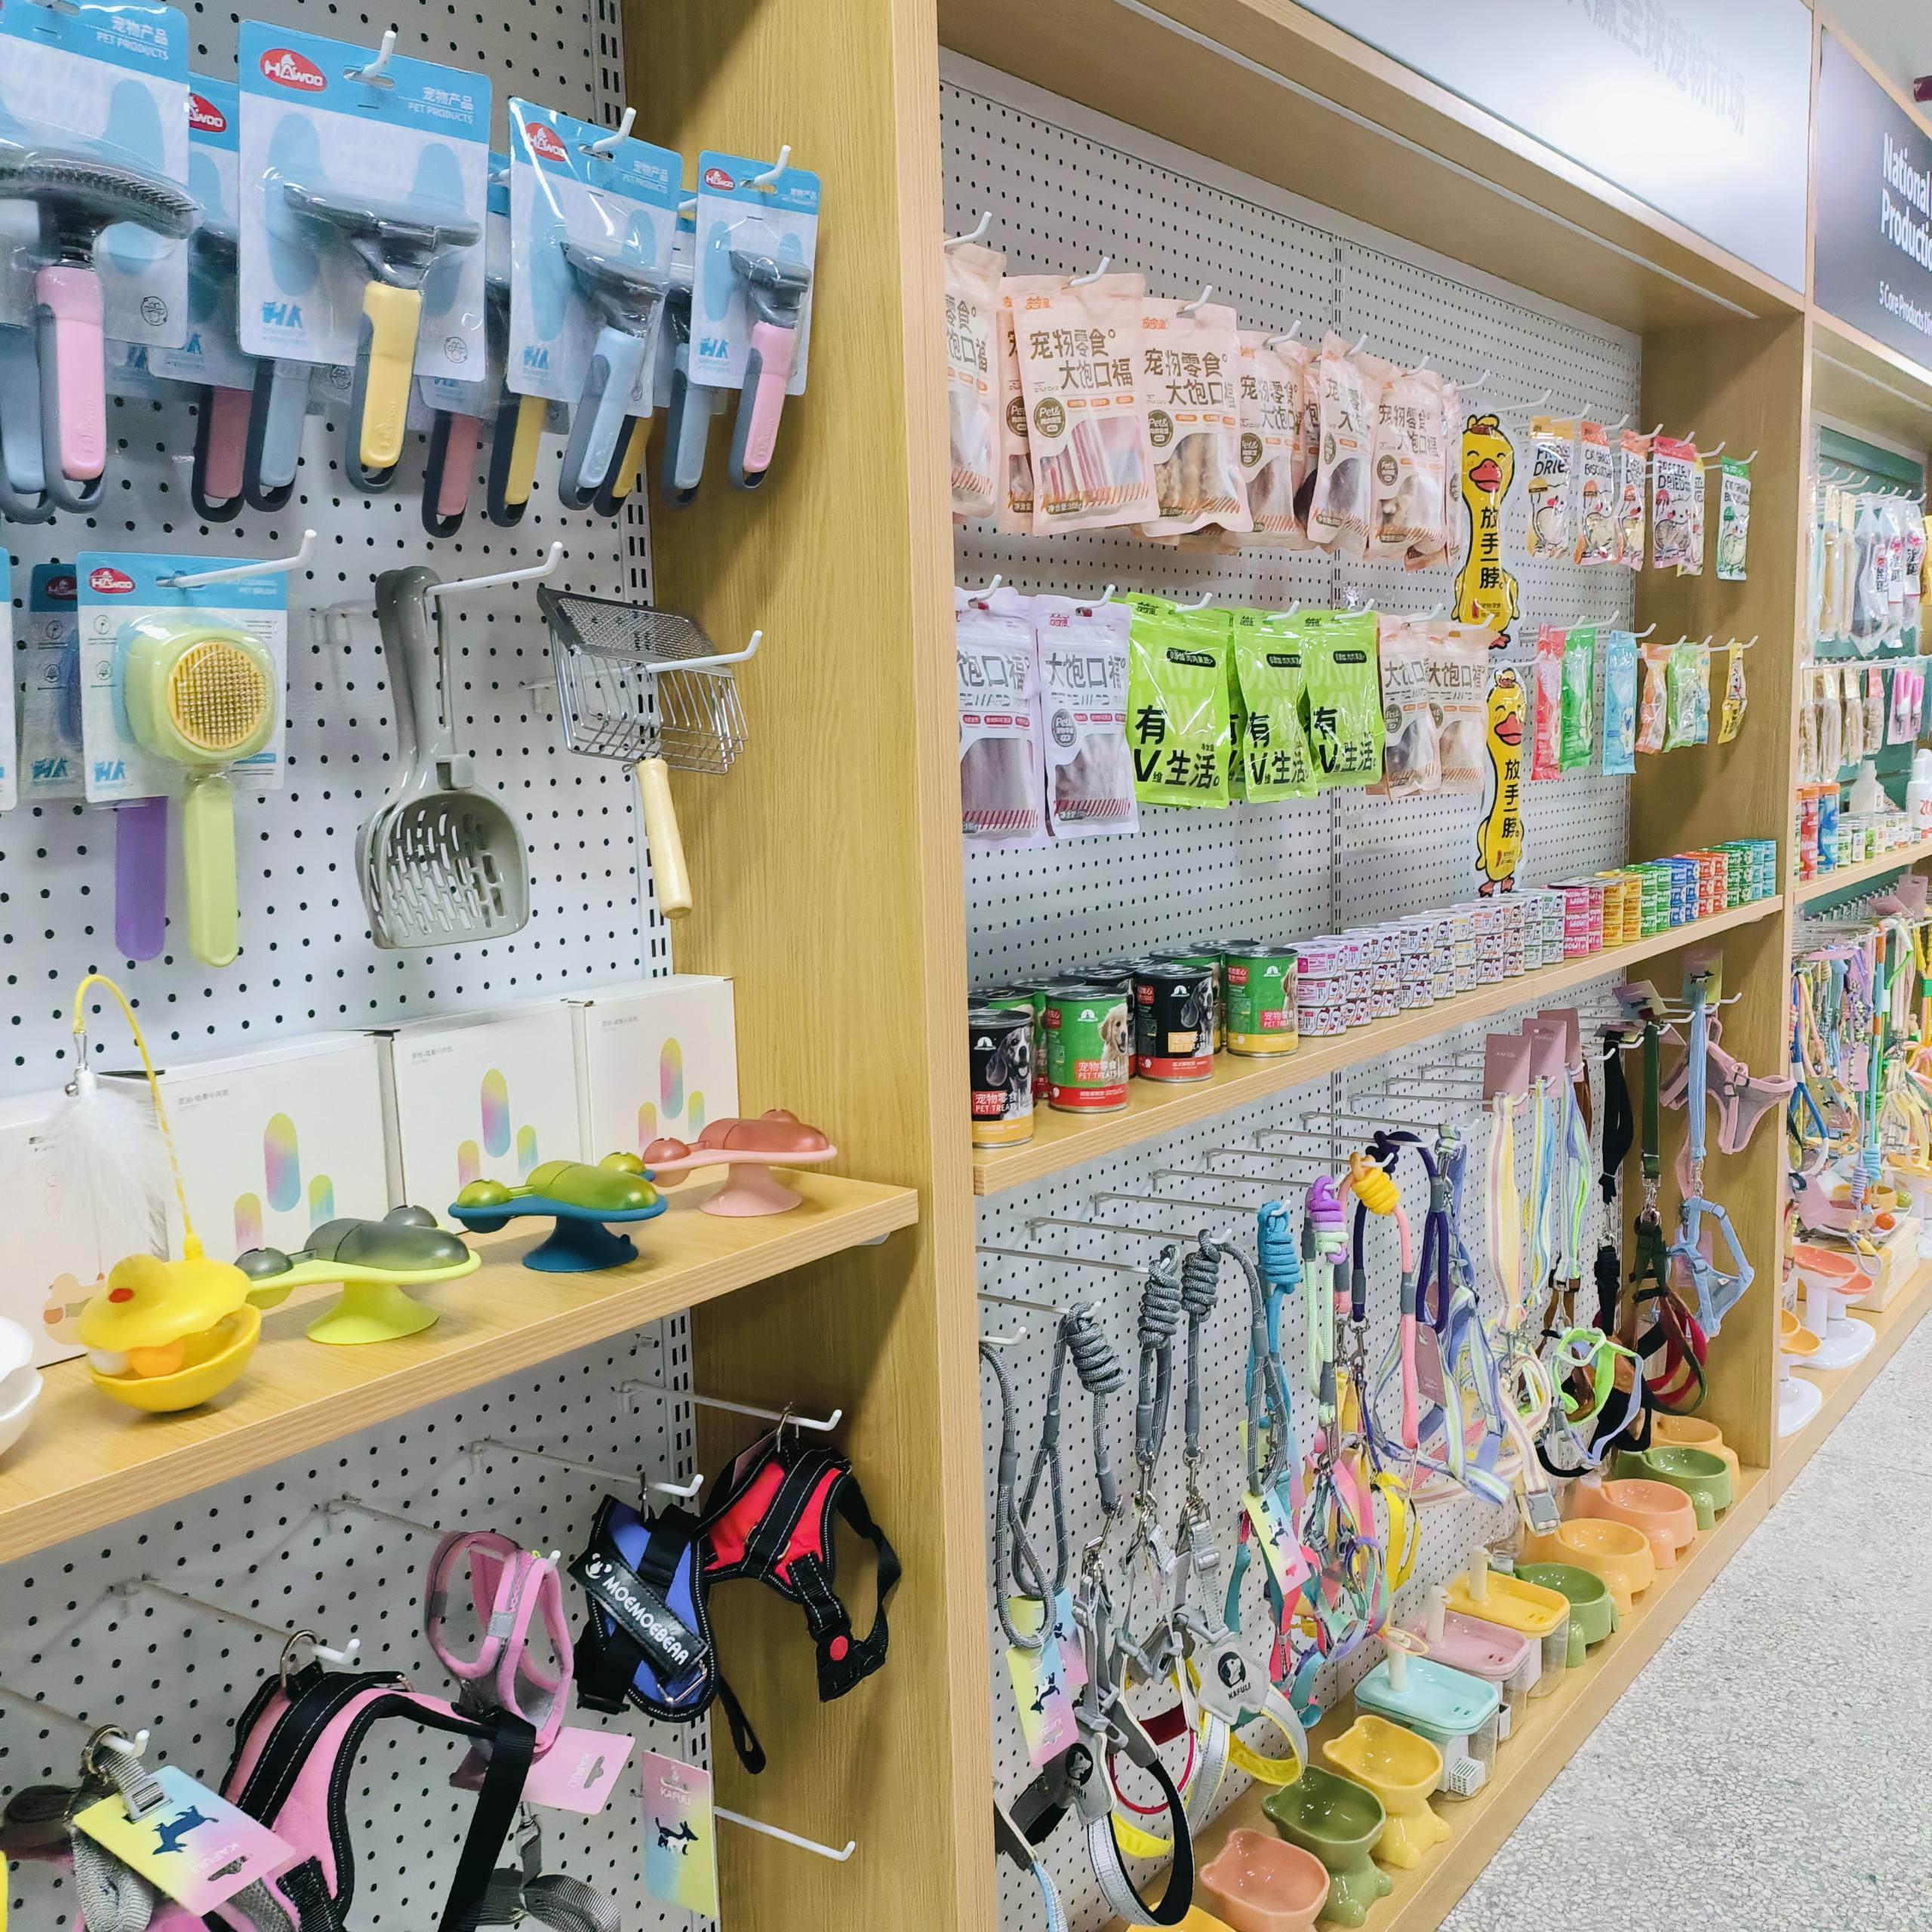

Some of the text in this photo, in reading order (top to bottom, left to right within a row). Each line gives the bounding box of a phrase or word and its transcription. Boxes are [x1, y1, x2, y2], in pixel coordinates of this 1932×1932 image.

[97, 31, 169, 60] PET PRODUCTS
[408, 102, 473, 125] PET PRODUCTS
[423, 87, 473, 111] 宠物产品
[1882, 133, 1930, 217] National
[1884, 283, 1899, 315] Core
[1059, 358, 1134, 390] 大饱口福
[1166, 379, 1236, 408] 大饱口福
[1135, 705, 1166, 745] 有
[1250, 712, 1269, 748] 有
[1078, 1072, 1091, 1080] PET
[976, 1104, 989, 1112] PET
[1228, 1682, 1251, 1700] KAFULI
